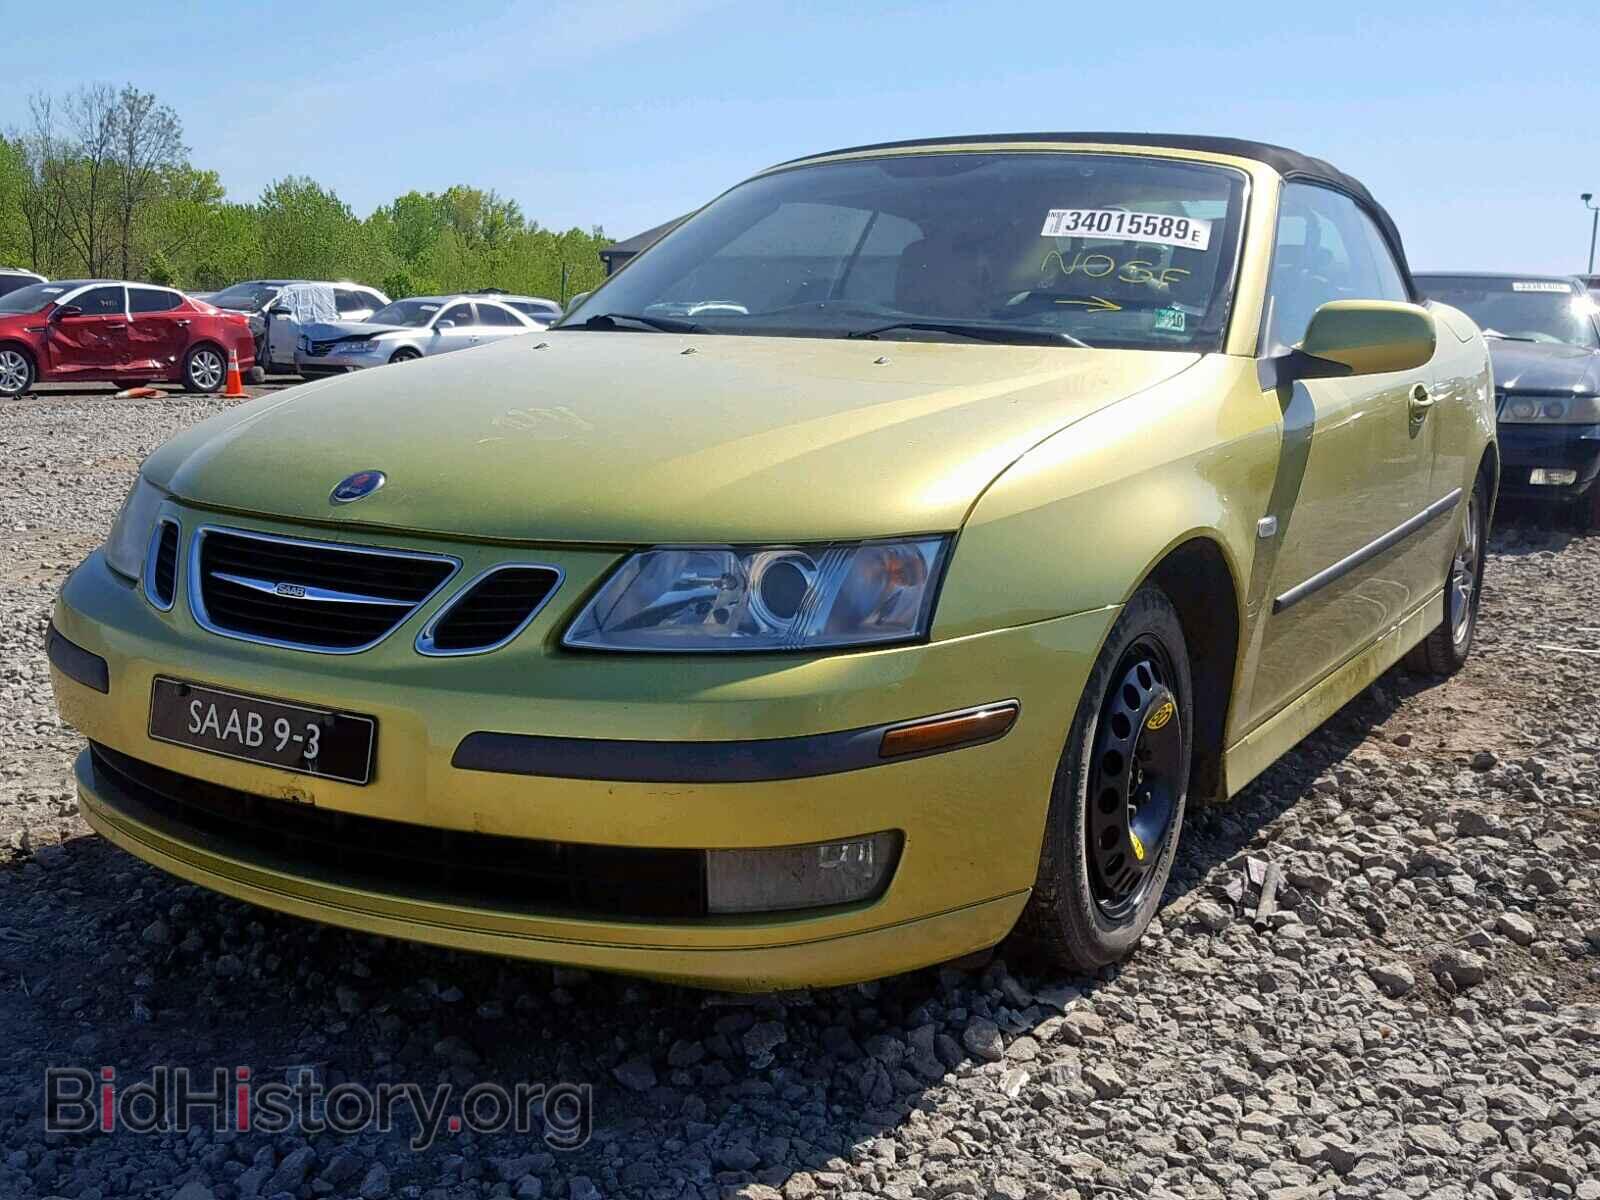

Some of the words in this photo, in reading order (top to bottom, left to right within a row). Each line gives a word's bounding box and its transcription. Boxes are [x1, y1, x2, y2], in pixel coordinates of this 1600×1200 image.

[1065, 211, 1190, 240] 34015589
[1191, 229, 1201, 242] E
[188, 699, 264, 748] SAAB
[273, 717, 321, 760] 9-3
